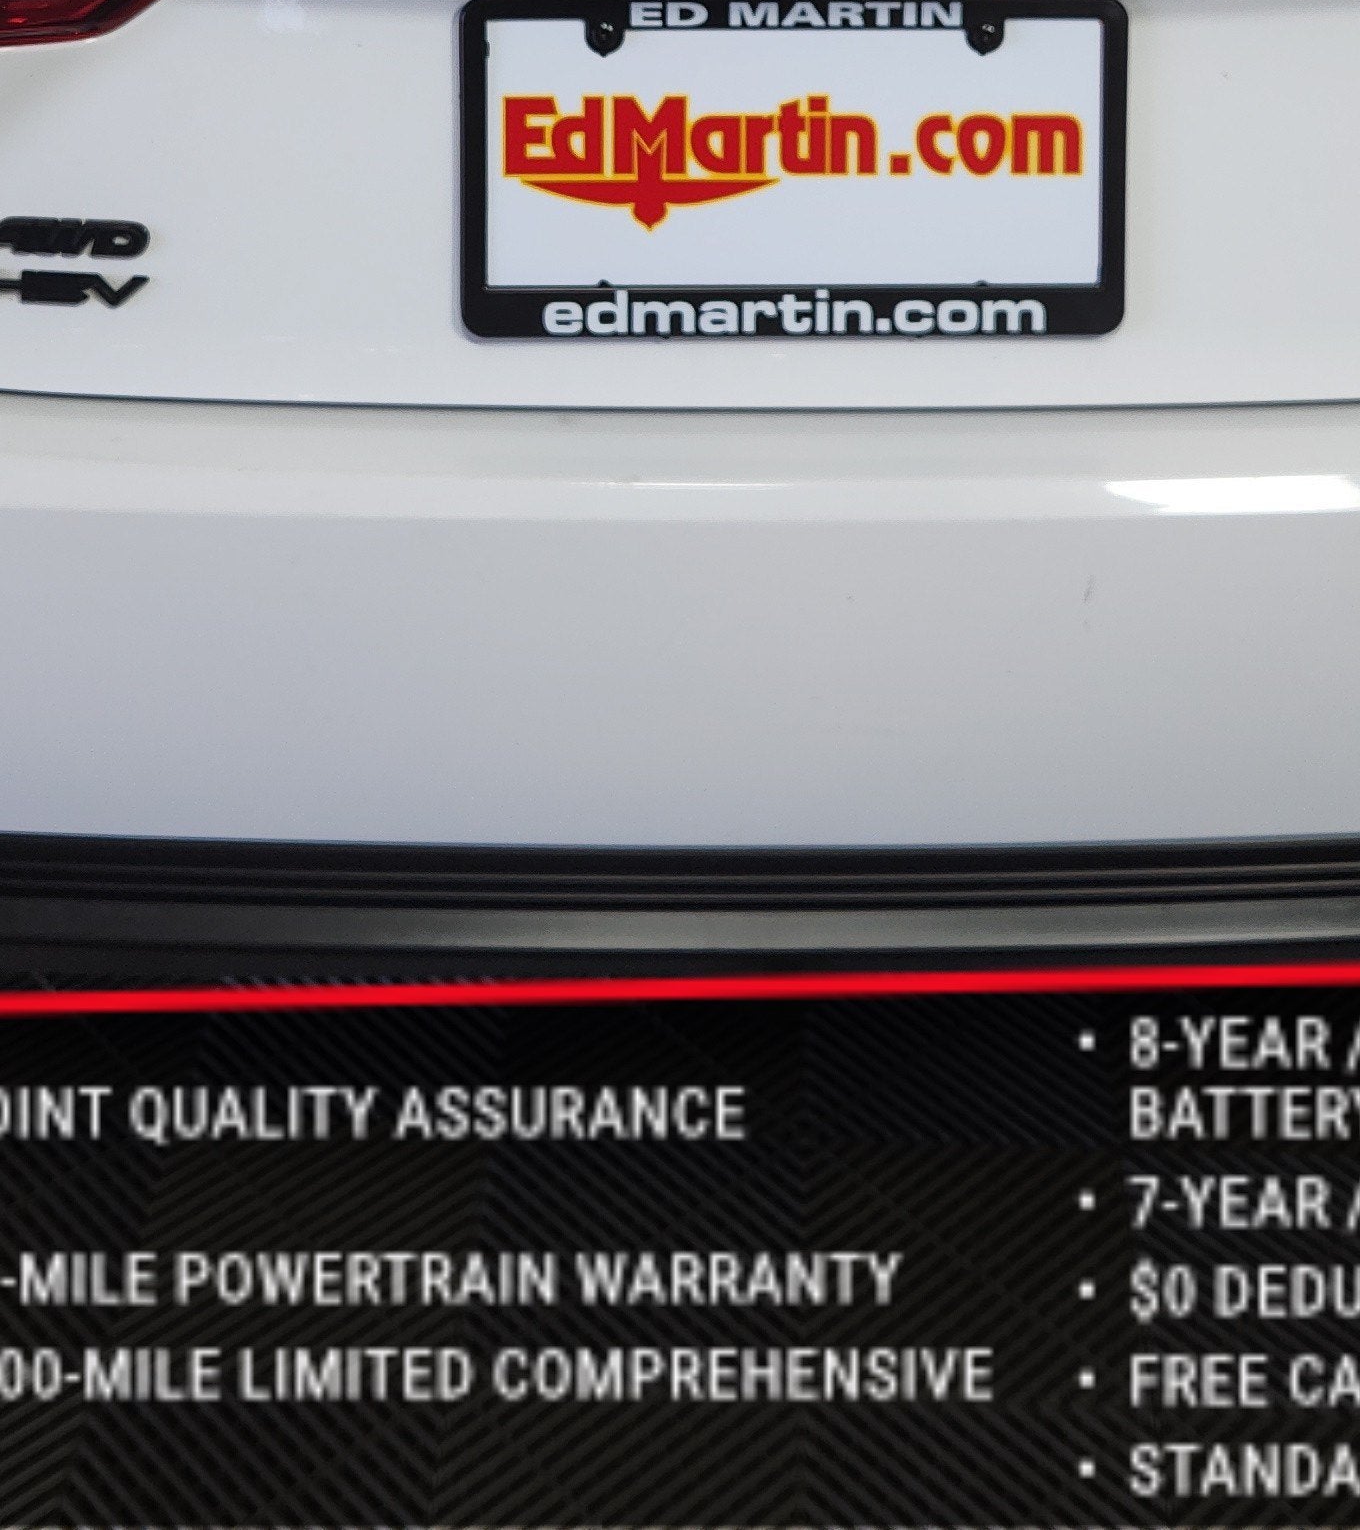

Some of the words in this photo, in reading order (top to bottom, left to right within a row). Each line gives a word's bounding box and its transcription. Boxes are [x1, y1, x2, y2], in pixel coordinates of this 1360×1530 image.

[629, 1, 709, 29] ED
[728, 1, 964, 29] MARTIN
[542, 290, 1046, 336] edmartin.com
